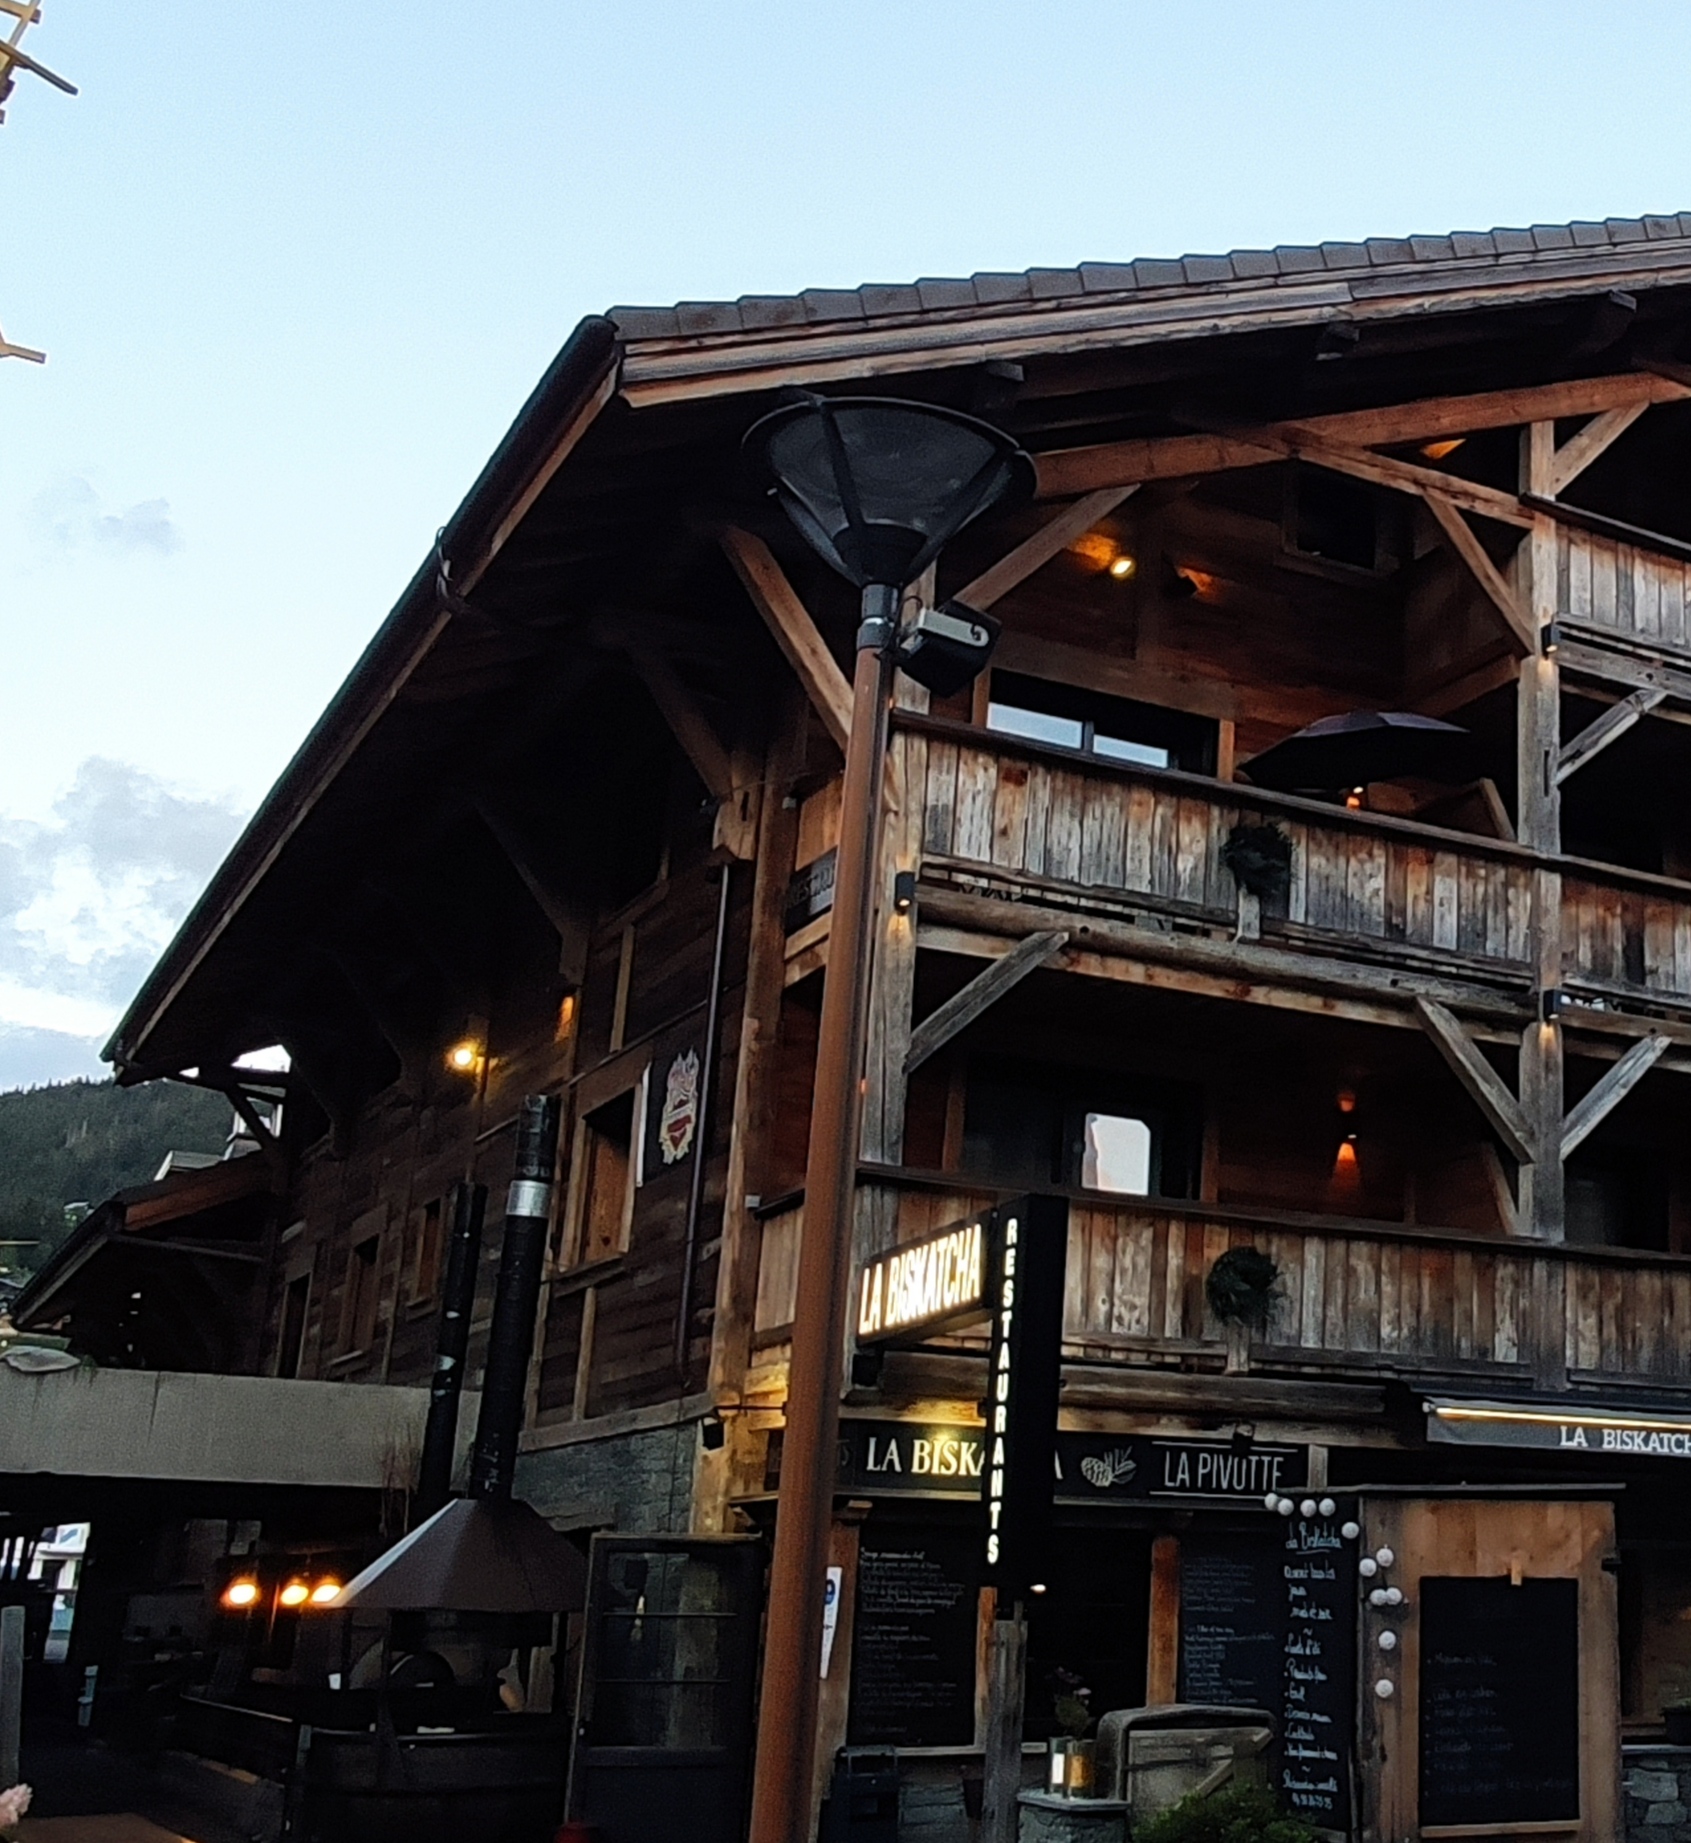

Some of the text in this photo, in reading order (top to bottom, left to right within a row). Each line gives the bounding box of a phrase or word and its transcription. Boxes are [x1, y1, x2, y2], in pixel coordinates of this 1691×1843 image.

[858, 1223, 982, 1335] LA BISKATCHA
[985, 1217, 1018, 1565] RESTAURANTS
[866, 1436, 902, 1473] LA
[1560, 1425, 1589, 1448] LA
[1164, 1450, 1285, 1491] LA PIVOTTE
